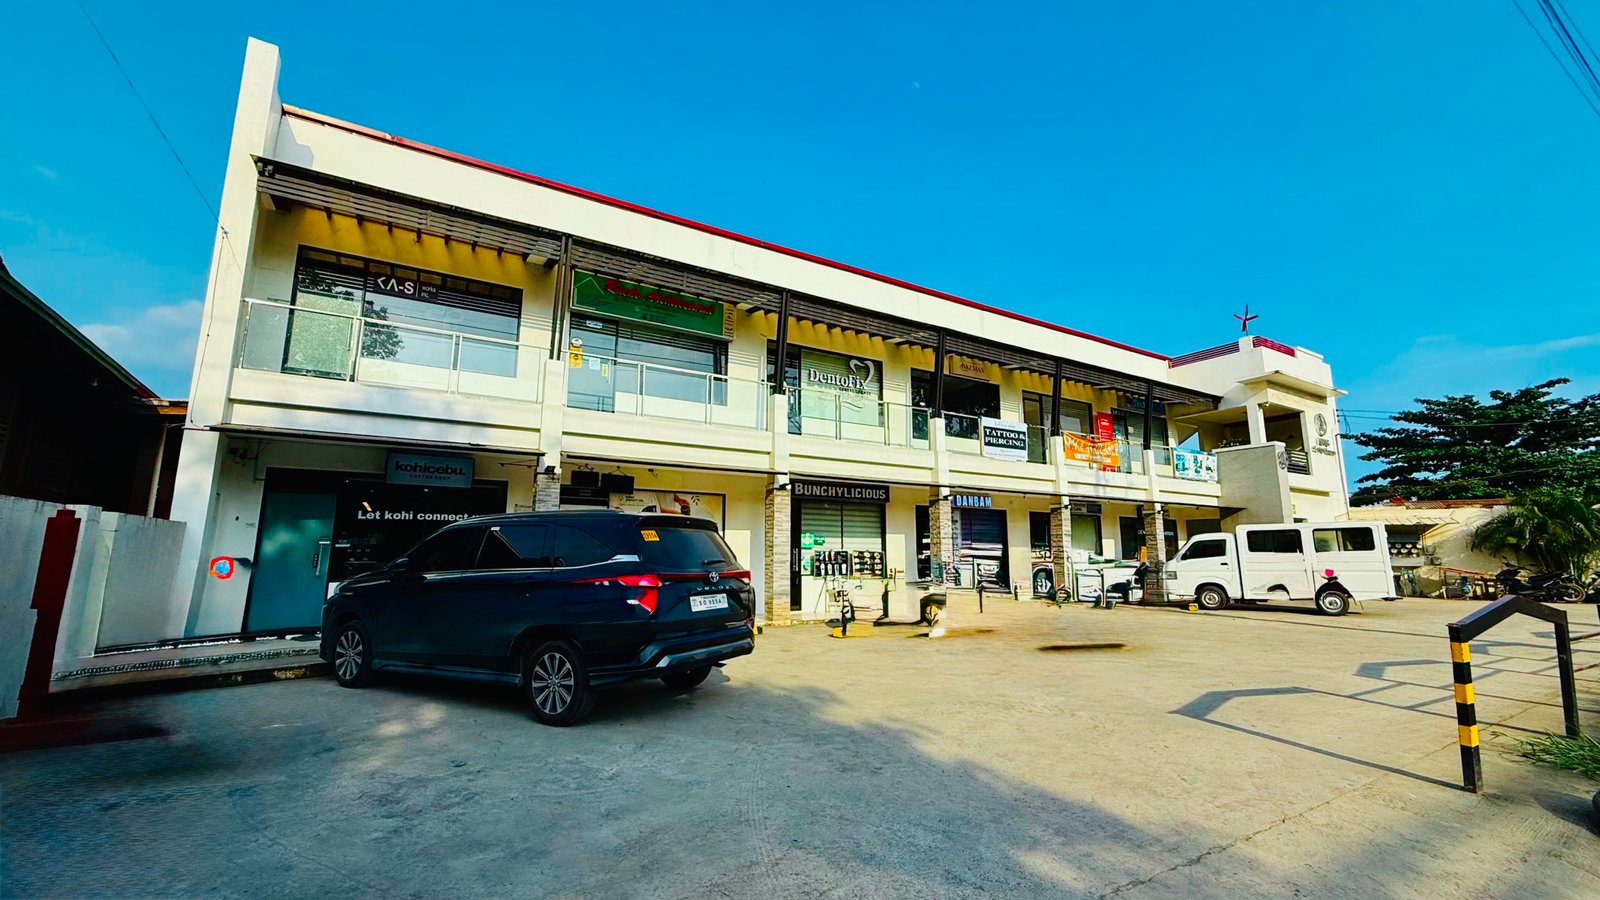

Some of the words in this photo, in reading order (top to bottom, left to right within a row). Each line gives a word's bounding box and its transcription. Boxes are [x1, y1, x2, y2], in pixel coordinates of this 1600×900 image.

[808, 368, 869, 390] DentoFix
[985, 428, 1019, 439] TATTOO
[985, 436, 1024, 447] PIERCING
[794, 482, 886, 499] BUNCHYLICIOUS
[956, 494, 992, 508] DANBAM
[357, 510, 381, 520] Let
[384, 511, 413, 521] kohi
[416, 512, 468, 521] connect
